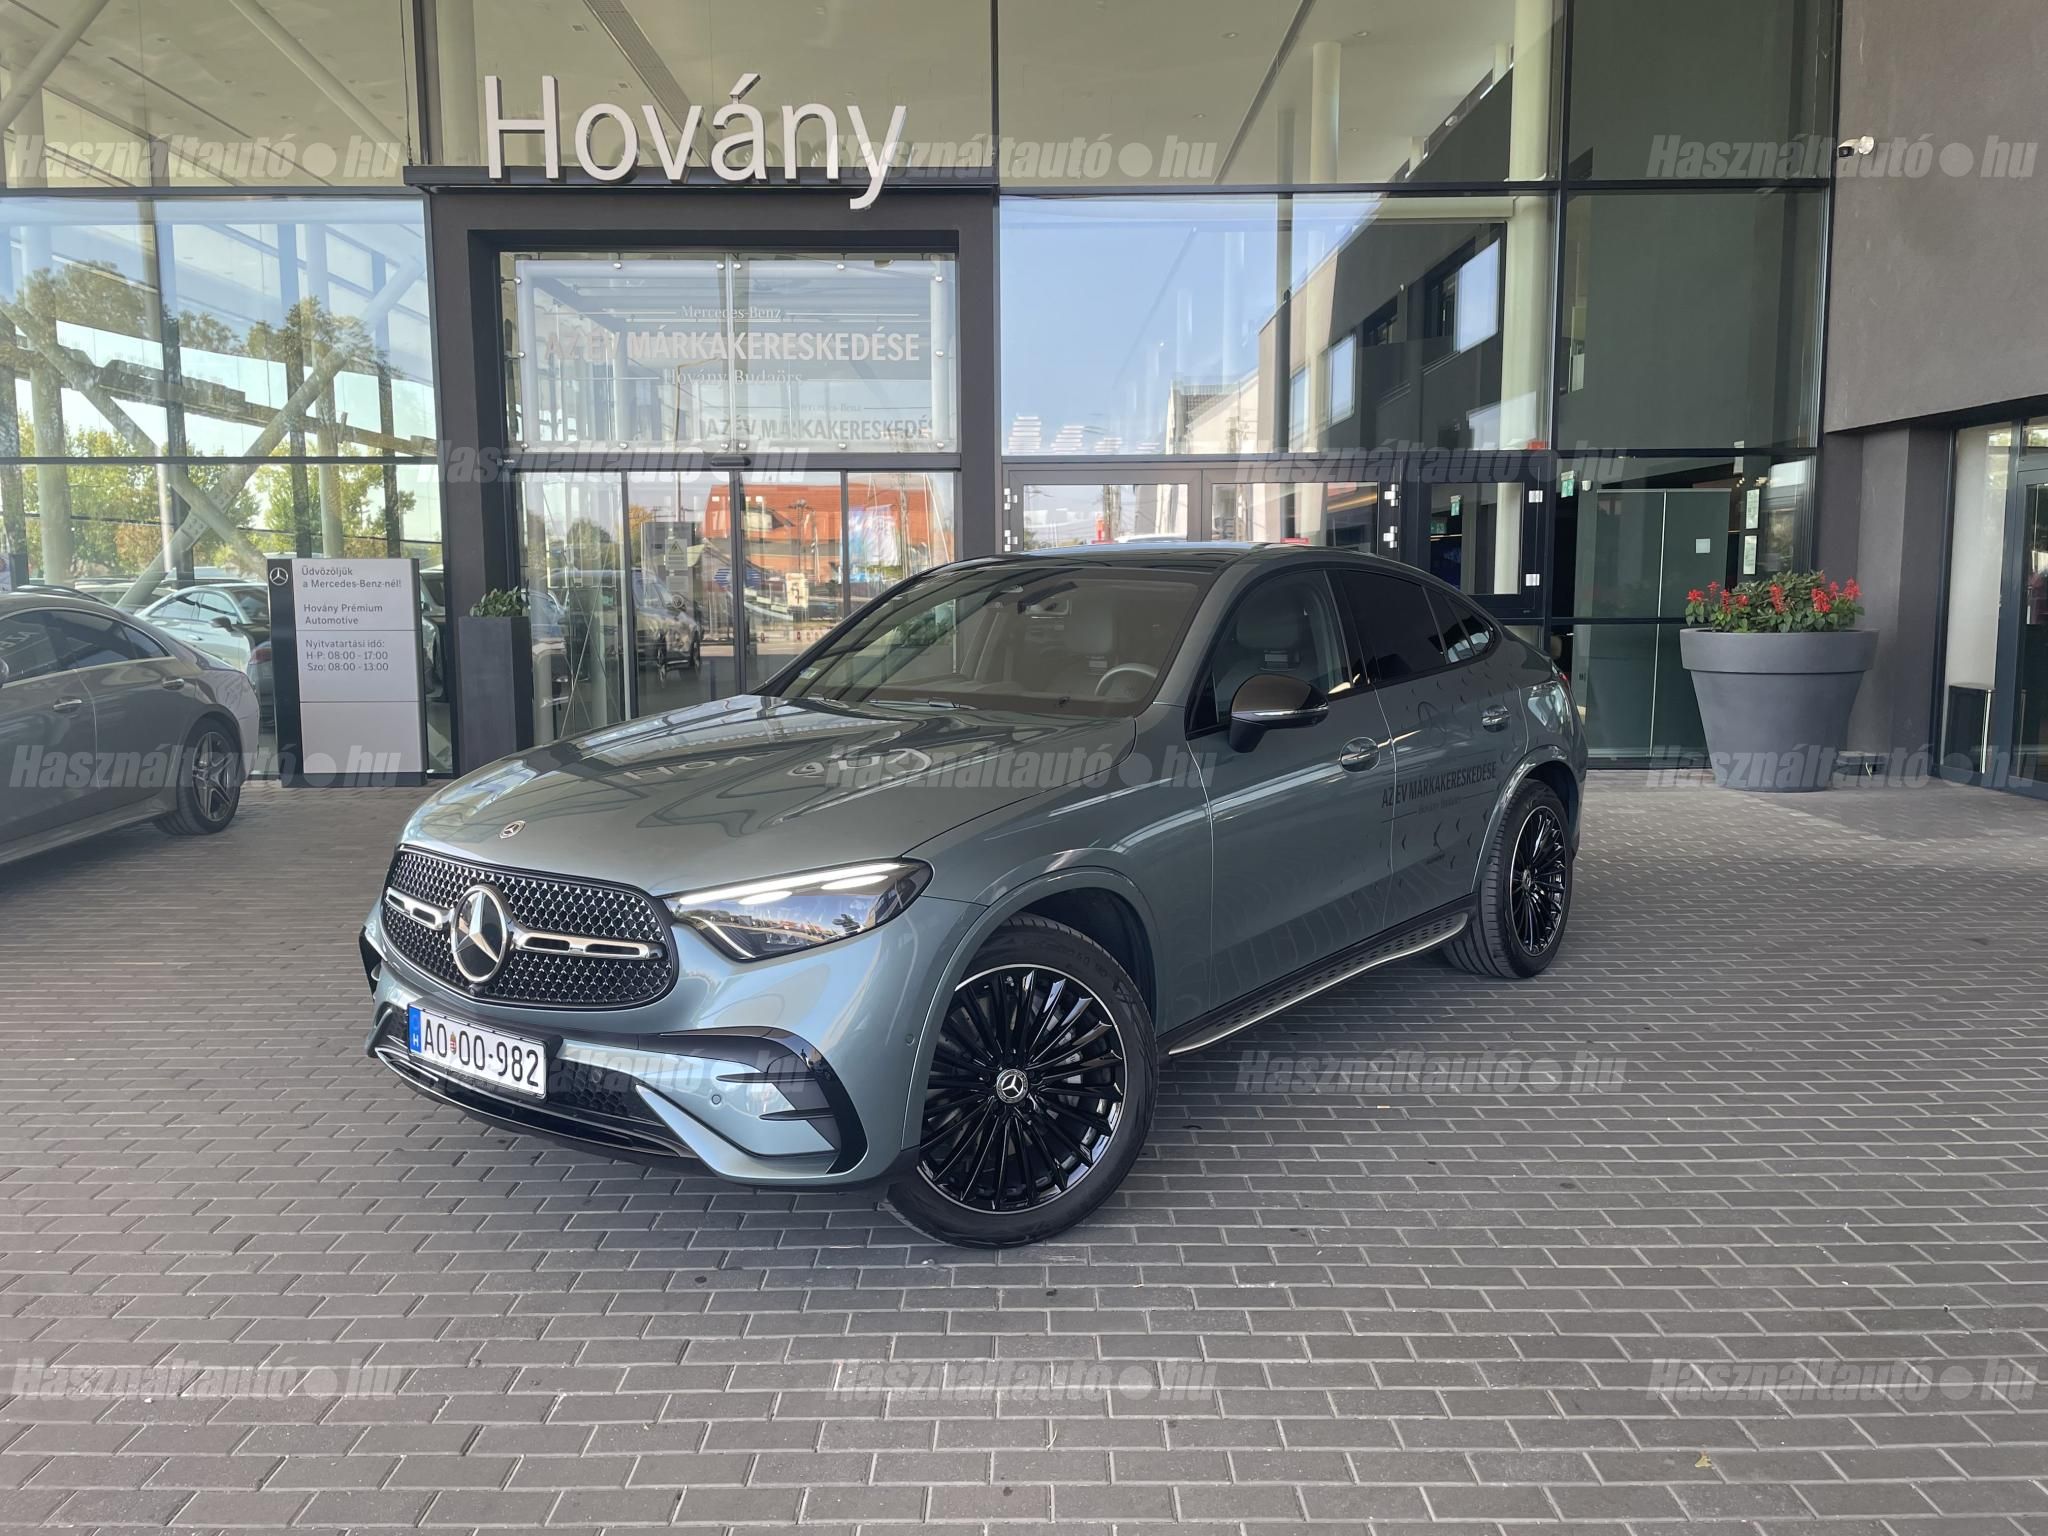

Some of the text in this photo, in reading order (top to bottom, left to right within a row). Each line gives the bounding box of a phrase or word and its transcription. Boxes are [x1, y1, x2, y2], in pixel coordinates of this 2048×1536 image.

[484, 73, 907, 210] Hovány
[681, 305, 782, 320] Mercedes-Benz
[627, 325, 920, 361] MÁRKAKERESKEDÉSE
[303, 602, 383, 615] Hovány Prémium
[305, 616, 359, 625] Automotive
[305, 639, 366, 651] Nyitvatartási
[327, 651, 356, 660] 08:00
[363, 651, 389, 660] 17:00
[328, 663, 356, 671] 08:00
[363, 663, 389, 671] 13:00
[412, 1033, 419, 1048] H
